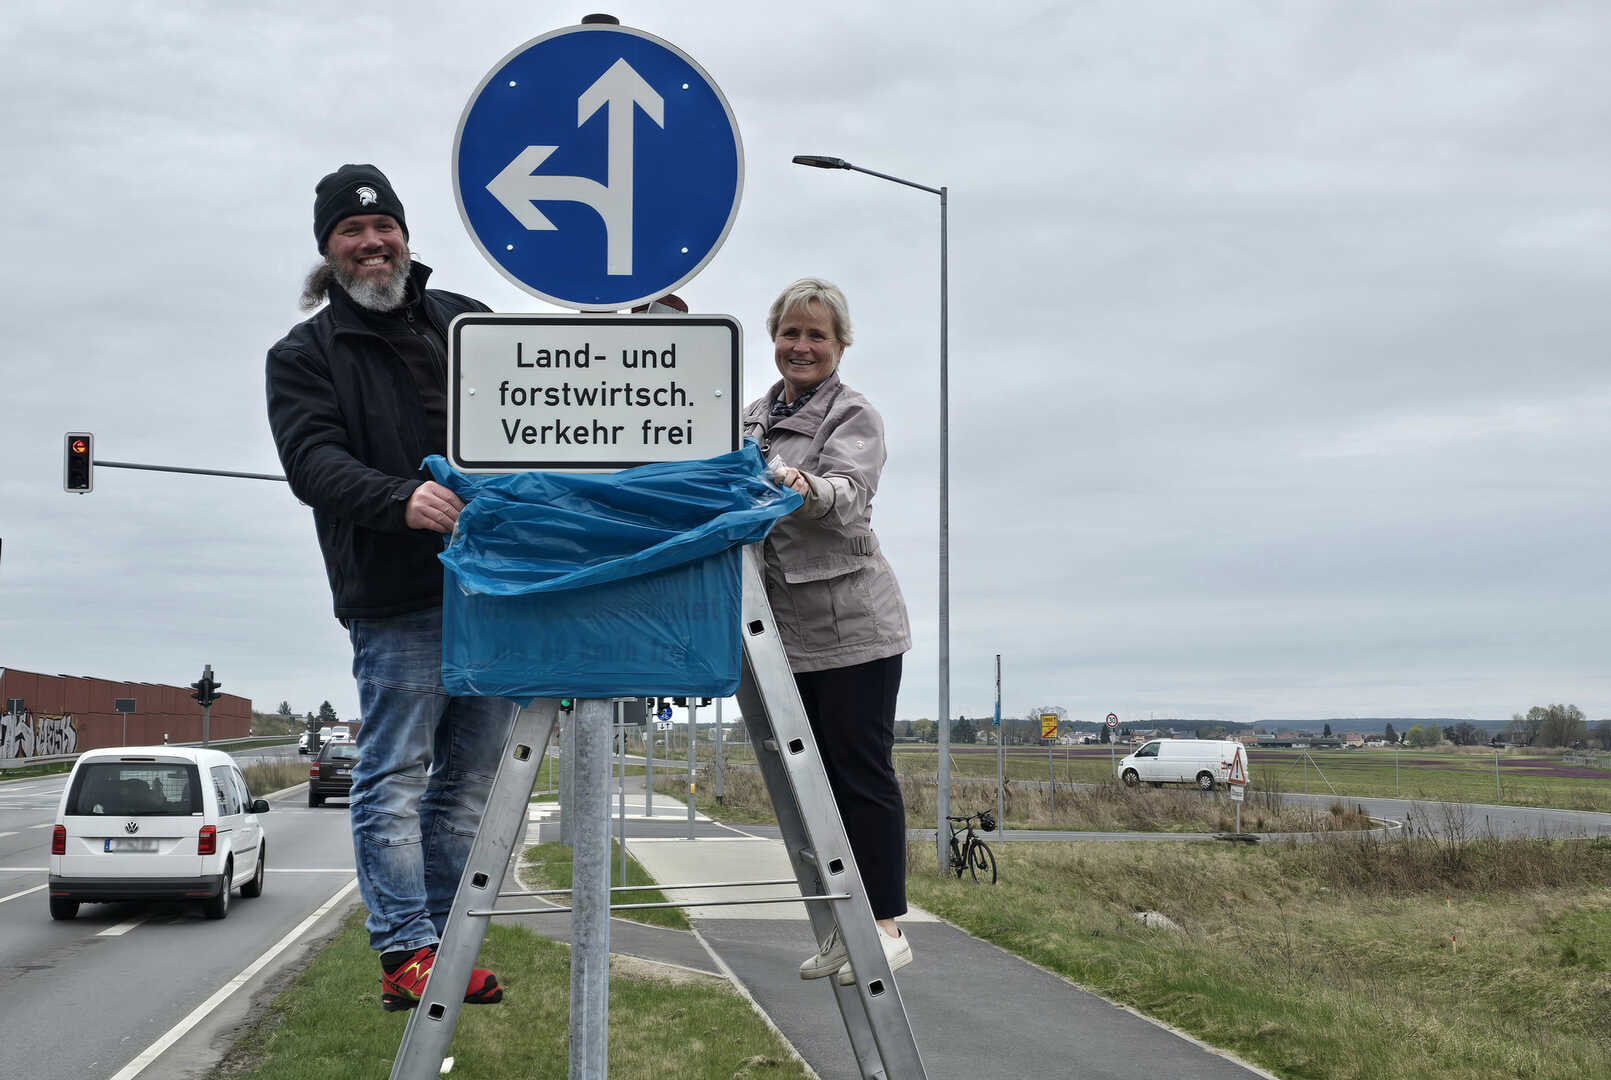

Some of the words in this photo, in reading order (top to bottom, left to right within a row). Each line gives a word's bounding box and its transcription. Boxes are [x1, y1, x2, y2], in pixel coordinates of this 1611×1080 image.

[516, 342, 607, 369] Land-
[622, 343, 677, 369] und
[499, 380, 695, 407] forstwirtsch.
[501, 418, 625, 445] Verkehr
[641, 418, 693, 445] frei
